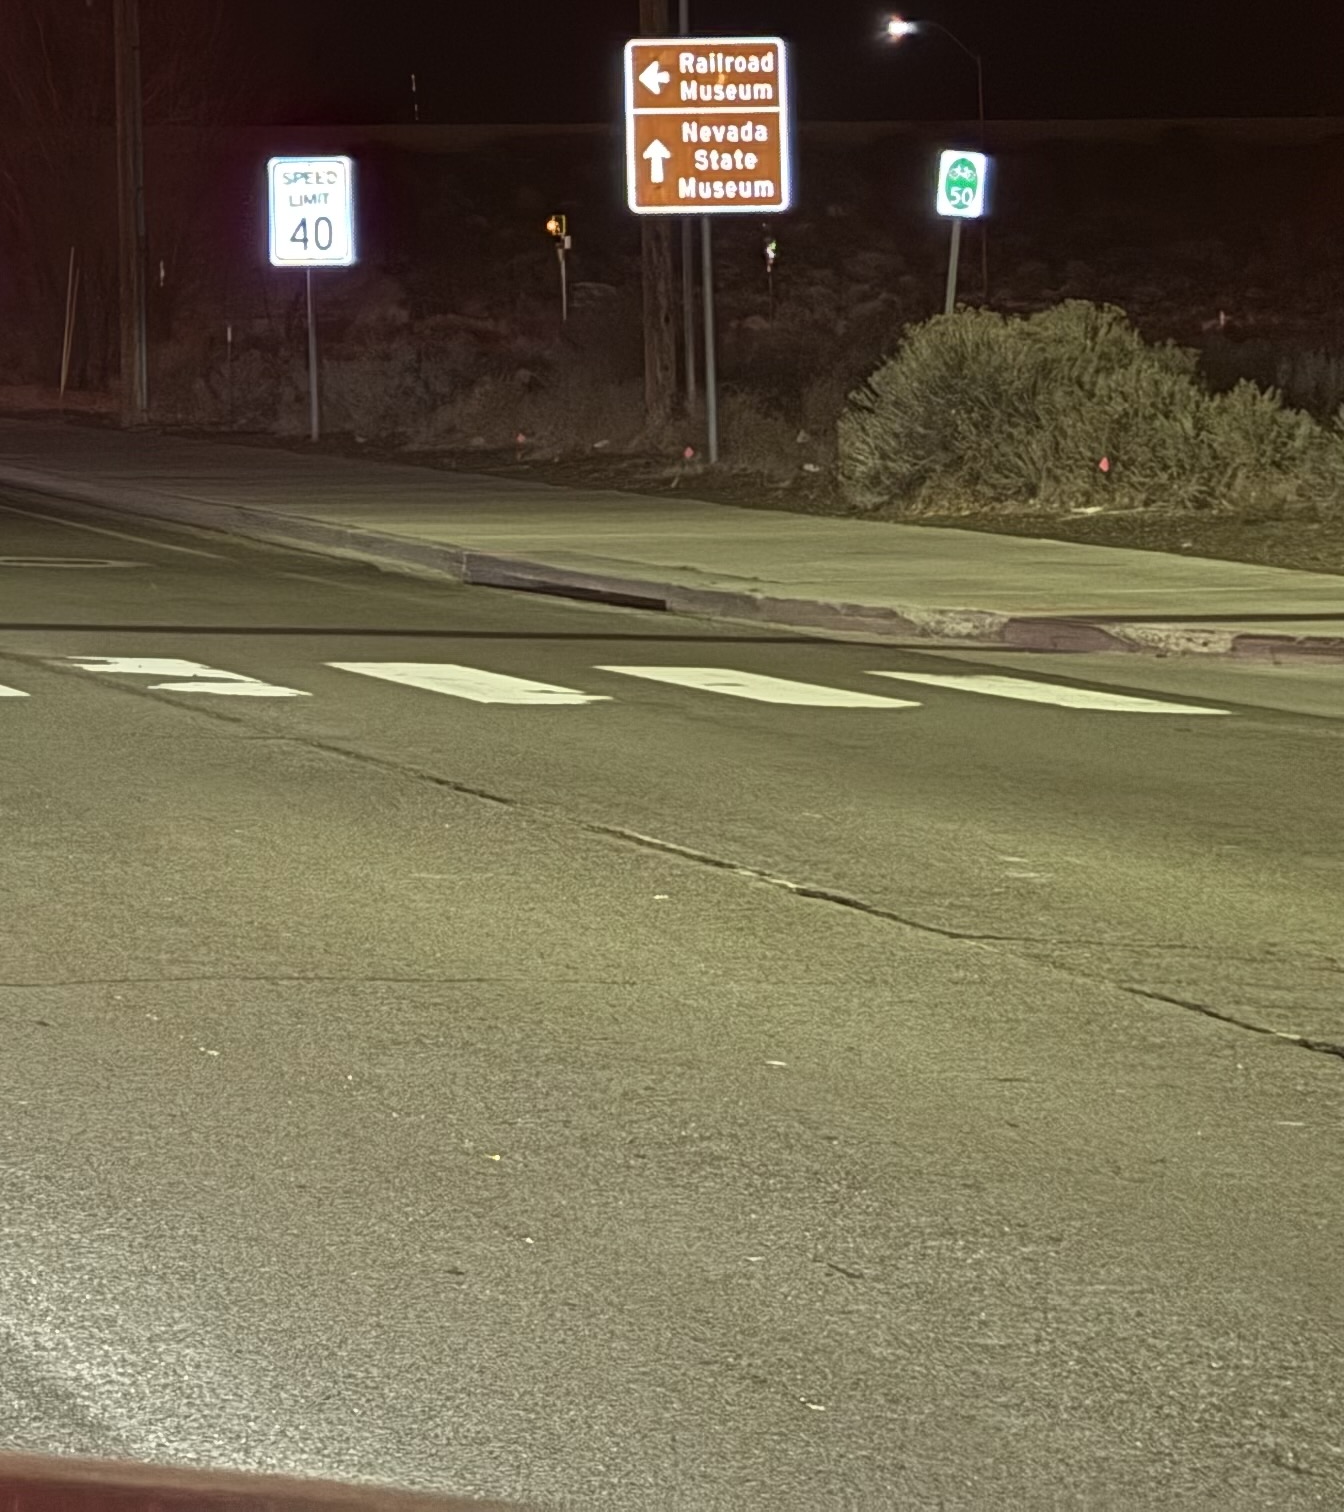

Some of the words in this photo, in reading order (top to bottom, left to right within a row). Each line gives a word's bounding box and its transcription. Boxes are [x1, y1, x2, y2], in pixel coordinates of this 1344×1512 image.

[678, 51, 775, 74] Railroad
[680, 79, 774, 102] Museum
[681, 120, 769, 143] Nevada
[694, 148, 759, 171] State
[282, 170, 338, 186] SPEED
[678, 176, 775, 199] Museum
[288, 192, 330, 208] LIMIT
[949, 185, 975, 207] 50
[289, 216, 333, 251] 40
